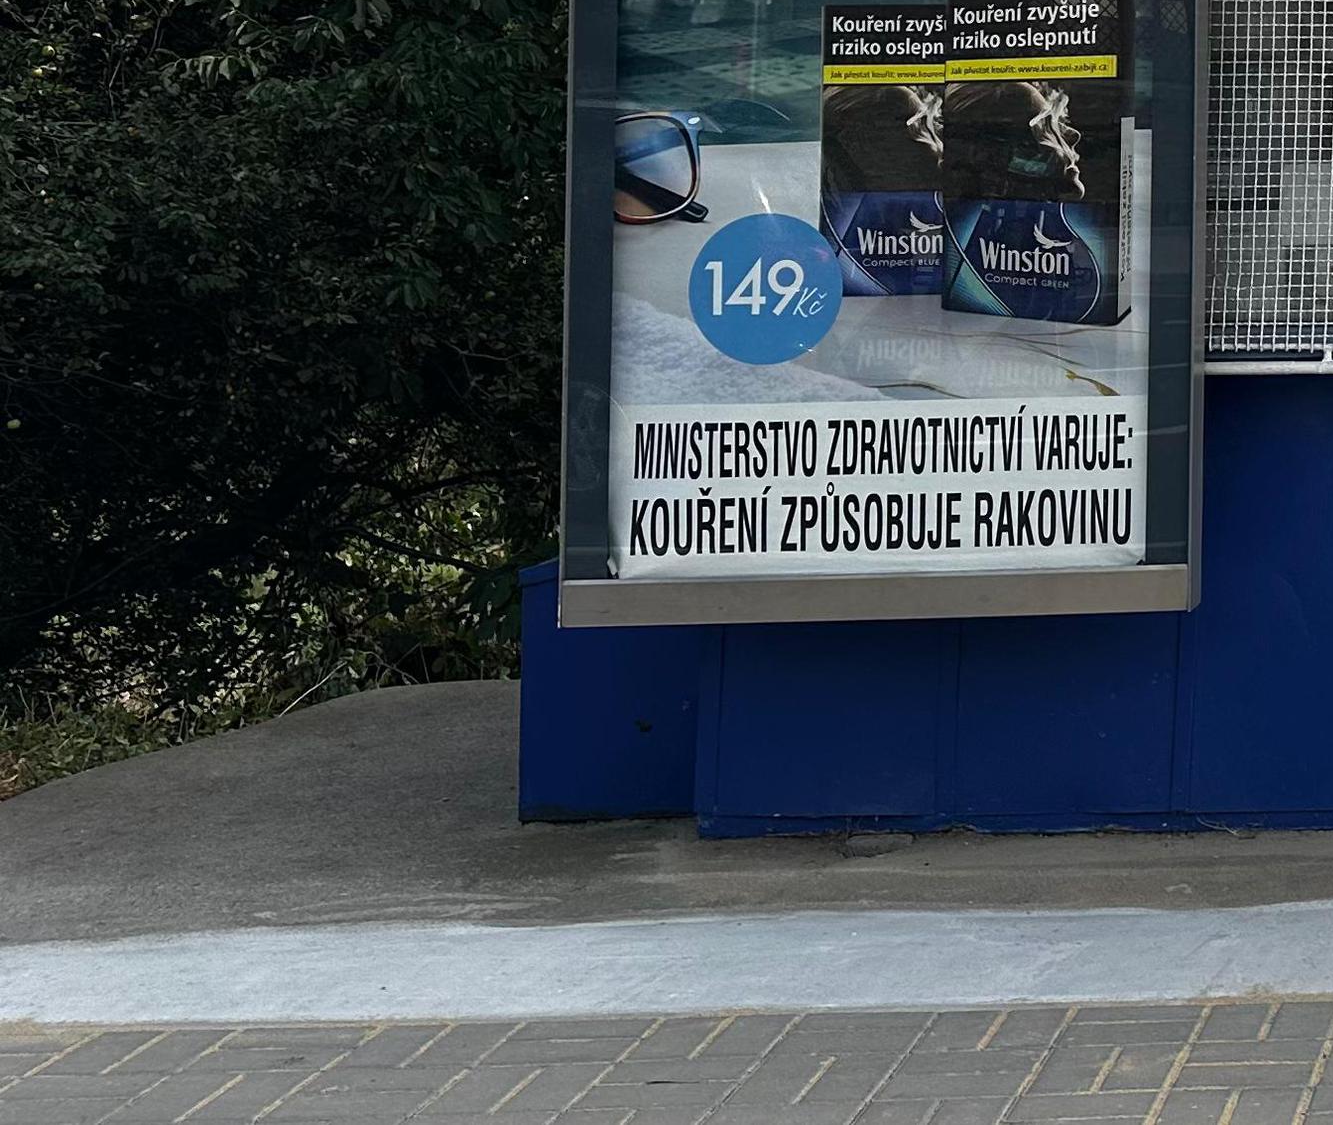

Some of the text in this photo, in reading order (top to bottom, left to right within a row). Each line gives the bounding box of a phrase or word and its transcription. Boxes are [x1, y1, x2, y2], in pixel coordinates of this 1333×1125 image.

[832, 15, 901, 33] Kouření
[953, 0, 1101, 25] Kouření zvyšuje
[832, 38, 881, 56] riziko
[953, 24, 1097, 50] riziko oslepnutí
[857, 227, 943, 255] Winston
[862, 258, 940, 267] Compact BLUE
[979, 237, 1070, 276] Winston
[704, 257, 827, 317] 149 Kč
[985, 273, 1038, 286] Compact
[633, 406, 1133, 481] MINISTERSTVO ZDRAVOTNICTVÍ VARUJE:
[629, 483, 1133, 557] KOUŘENÍ ZPŮSOBUJE RAKOVINU
